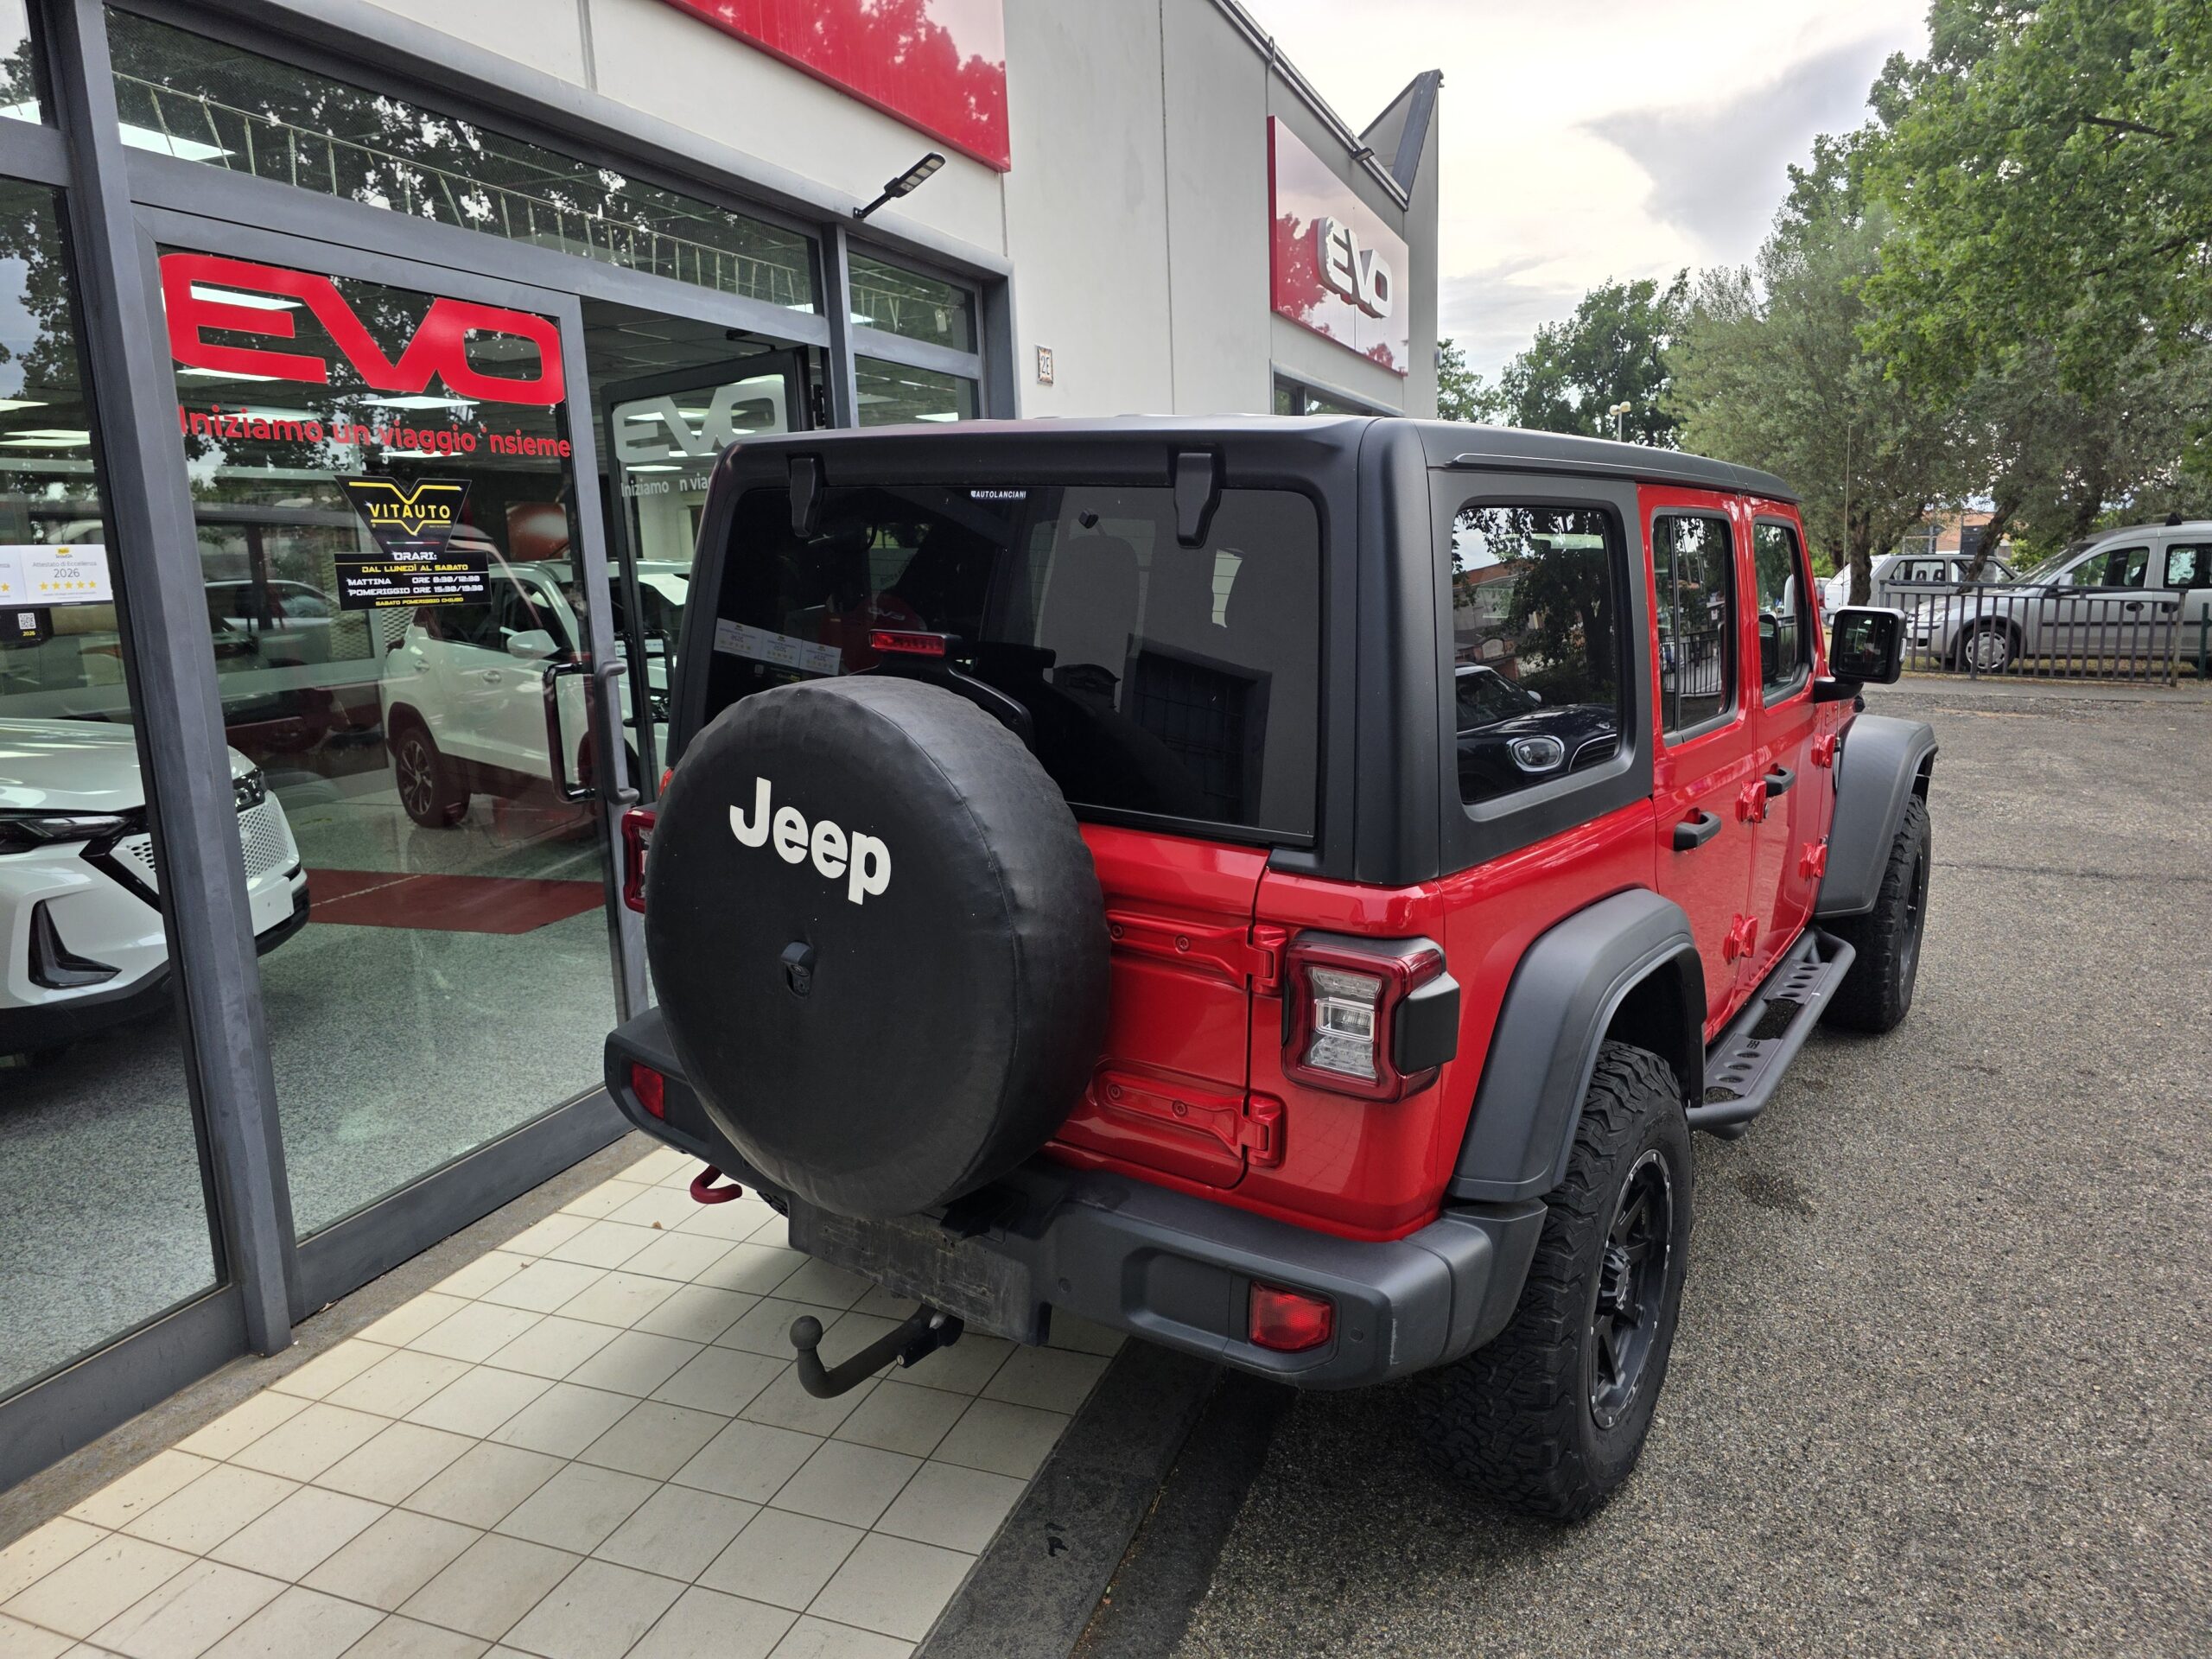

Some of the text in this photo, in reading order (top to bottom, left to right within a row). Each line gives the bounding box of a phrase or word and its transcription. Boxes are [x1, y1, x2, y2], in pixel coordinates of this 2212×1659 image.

[1320, 216, 1393, 318] EVO
[159, 253, 565, 406] EVO
[612, 374, 788, 463] EVO
[179, 404, 571, 458] Iniziamo un viaggio nsieme
[621, 477, 670, 498] Iniziamo
[976, 490, 1027, 499] AUTOLANCIANI
[370, 503, 451, 519] VITAUTO
[393, 551, 438, 562] ORARI:
[54, 568, 80, 578] 2026
[347, 577, 392, 586] MATTINA
[348, 588, 410, 596] POMERIGGIO
[729, 776, 892, 906] Jeep
